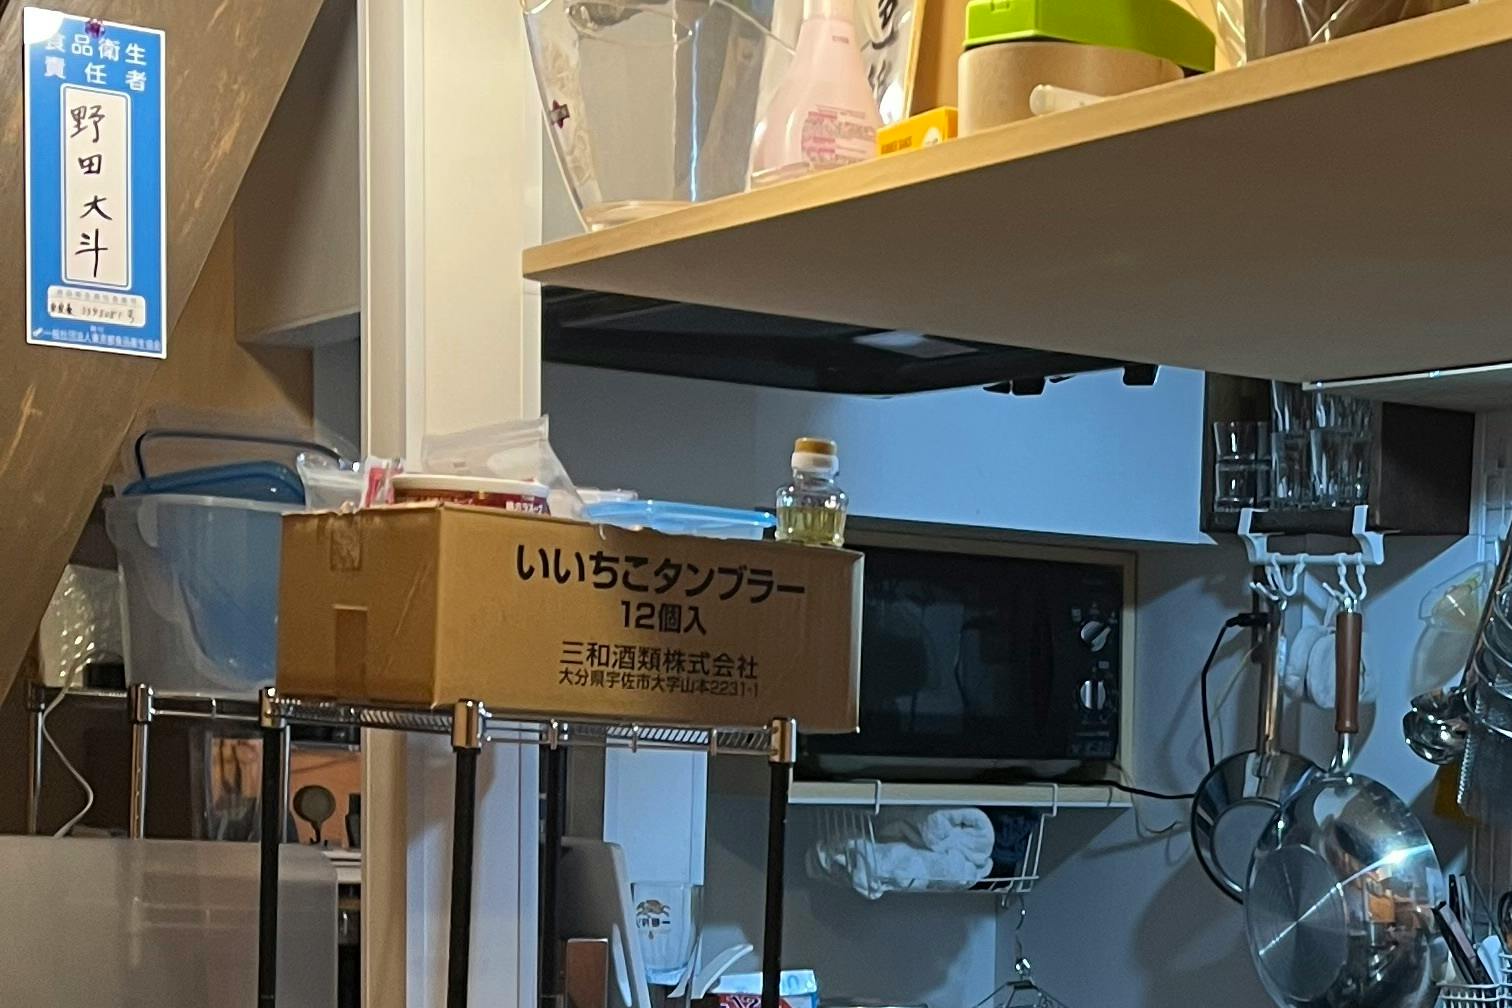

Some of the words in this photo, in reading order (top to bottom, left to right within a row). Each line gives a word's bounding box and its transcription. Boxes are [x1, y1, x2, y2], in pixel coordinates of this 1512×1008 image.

[70, 104, 113, 279] 野田大斗
[515, 544, 806, 604] いいちこタンブラー
[620, 600, 707, 636] 12個入
[559, 640, 759, 681] 三和酒類株式会社
